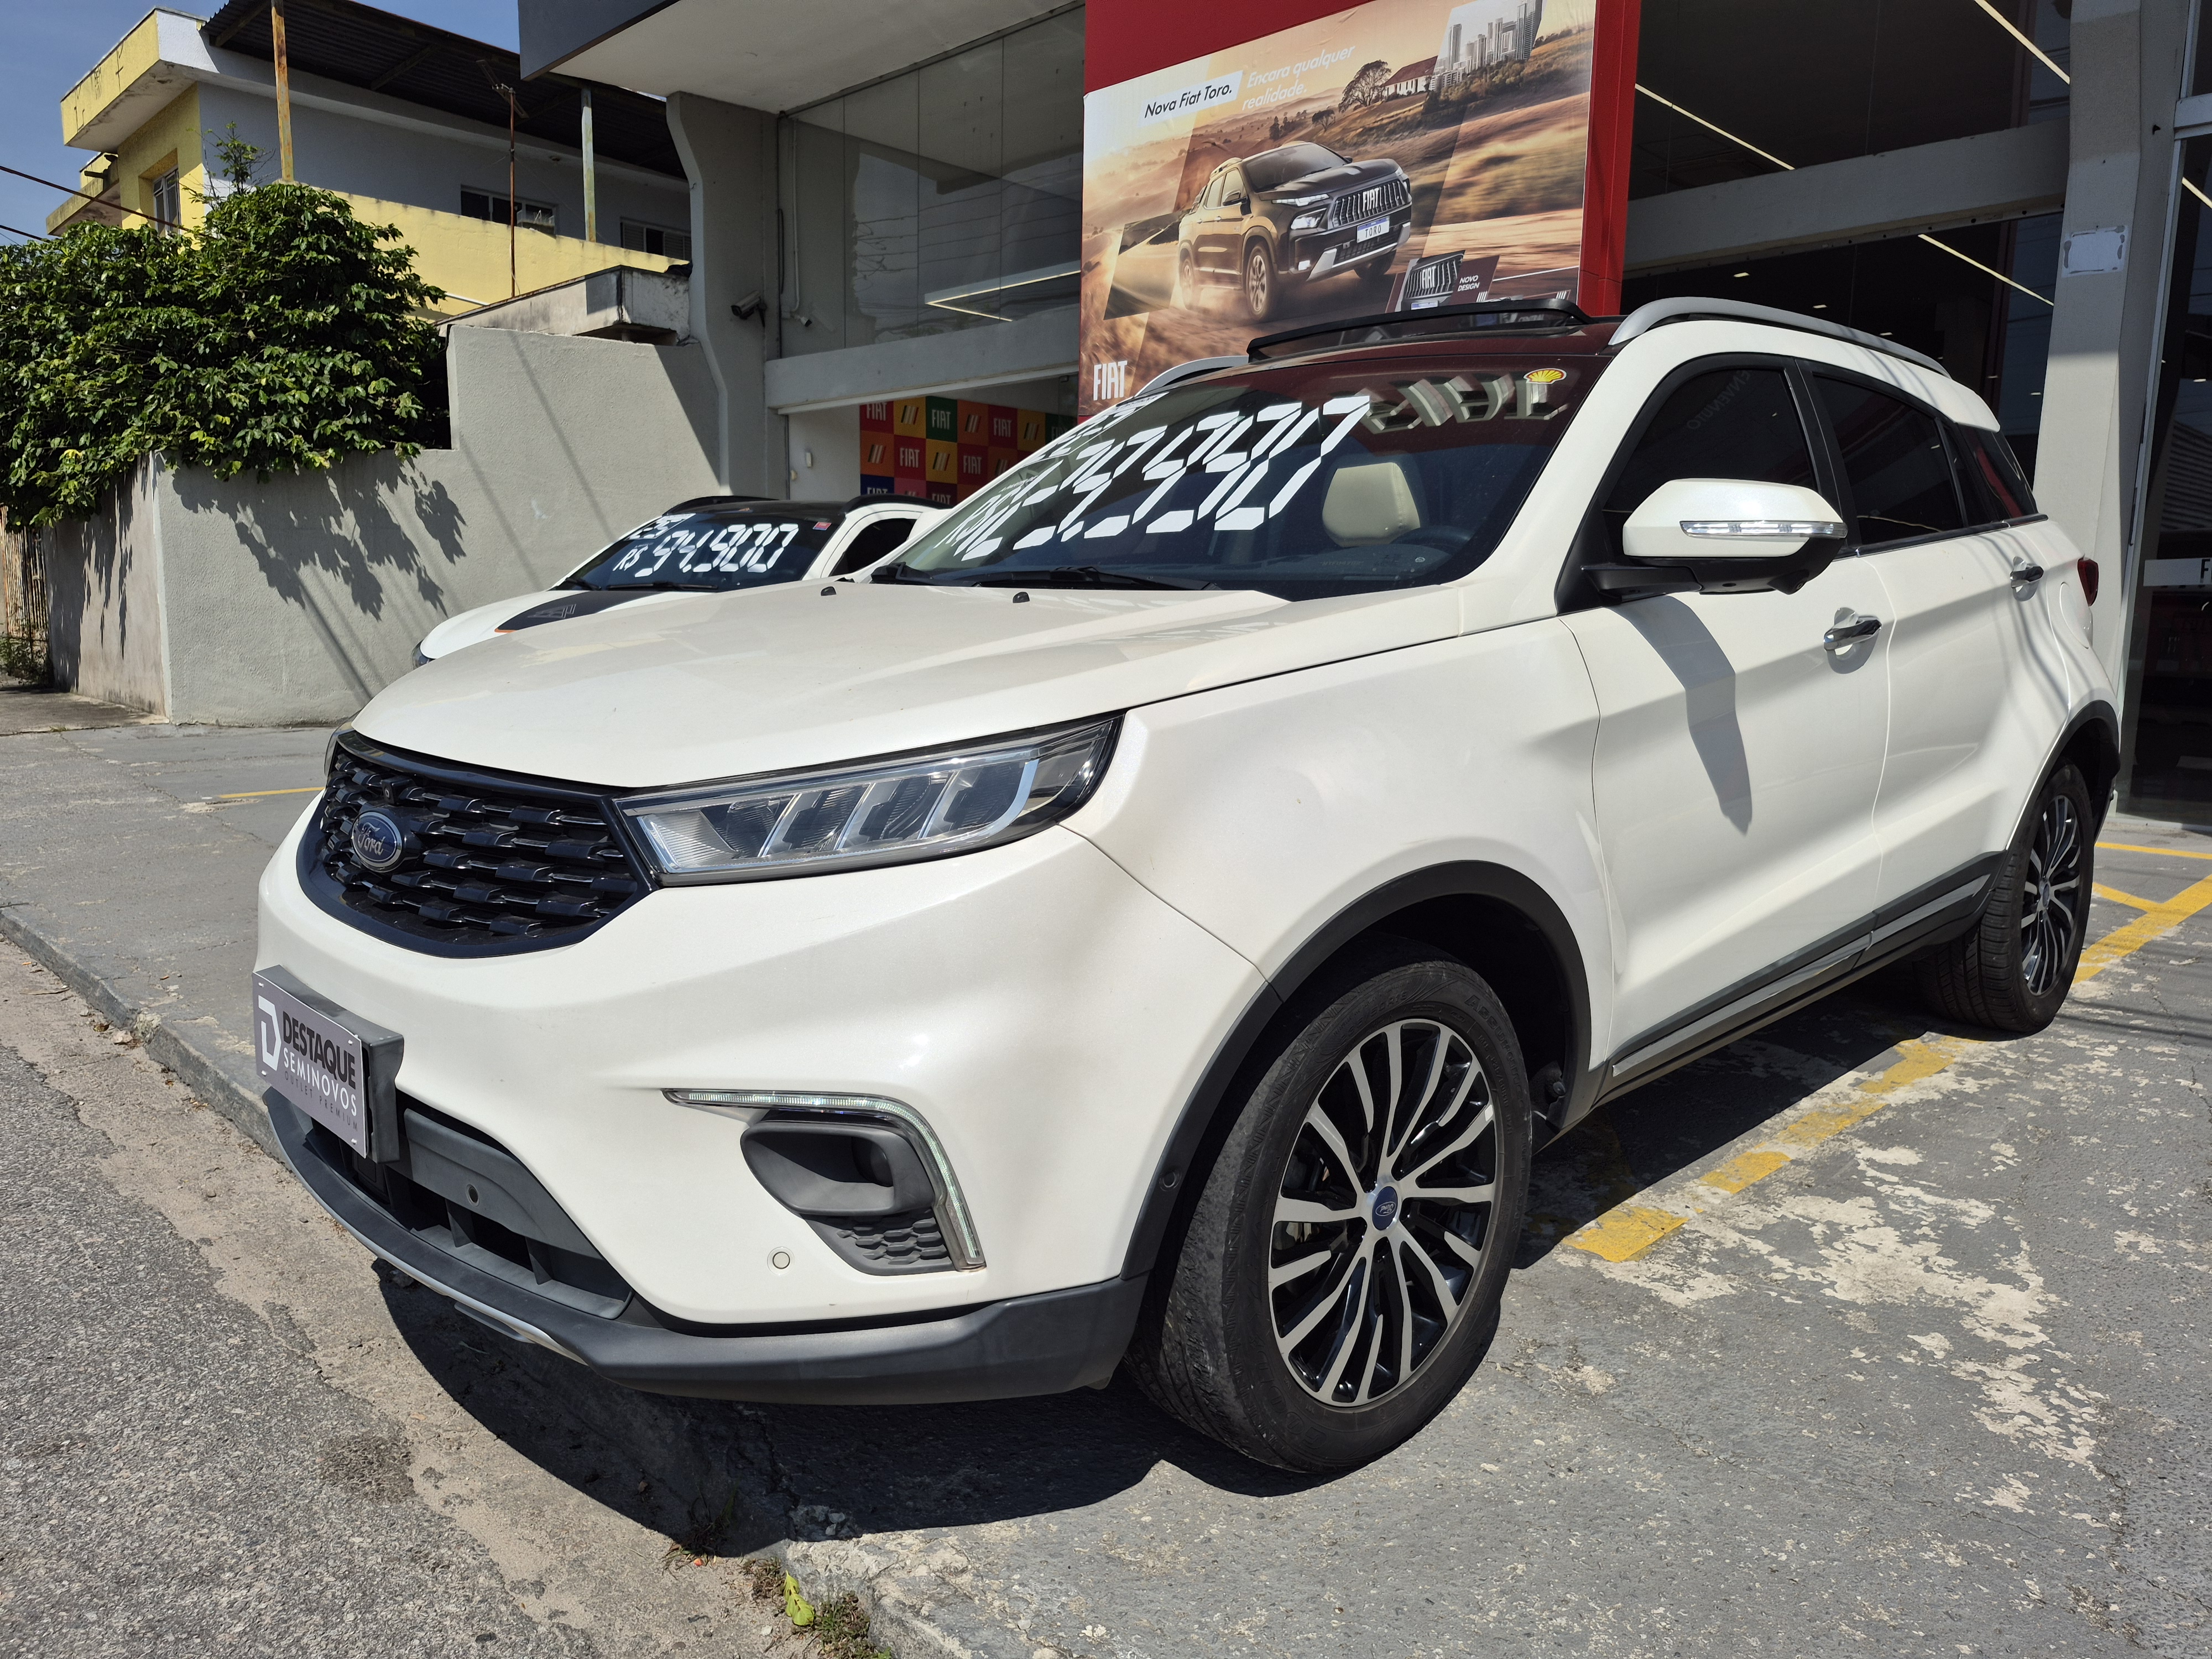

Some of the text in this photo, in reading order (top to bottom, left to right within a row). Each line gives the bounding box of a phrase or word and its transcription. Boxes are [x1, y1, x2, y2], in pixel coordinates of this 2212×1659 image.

[1246, 45, 1356, 88] Encara qualquer
[1144, 82, 1233, 118] Nova Fiat Toro.
[1241, 79, 1308, 111] realidade.
[1362, 187, 1380, 212] FIAT
[1365, 225, 1381, 238] TORO
[1421, 265, 1437, 289] FIAT
[1457, 282, 1480, 292] DESIGN
[1459, 275, 1479, 284] NOVO
[1093, 360, 1128, 401] FIAT
[866, 401, 887, 421] FIAT
[931, 409, 951, 430] FIAT
[993, 418, 1013, 437] FIAT
[900, 447, 920, 468] FIAT
[963, 455, 982, 475] FIAT
[613, 523, 799, 577] R$ 94.900
[357, 822, 387, 855] Ford
[282, 1010, 357, 1089] DESTAQUE
[283, 1047, 357, 1117] SEMINOVOS
[284, 1071, 358, 1131] OUTLET PREMIUM
[1379, 1203, 1394, 1214] Ford
